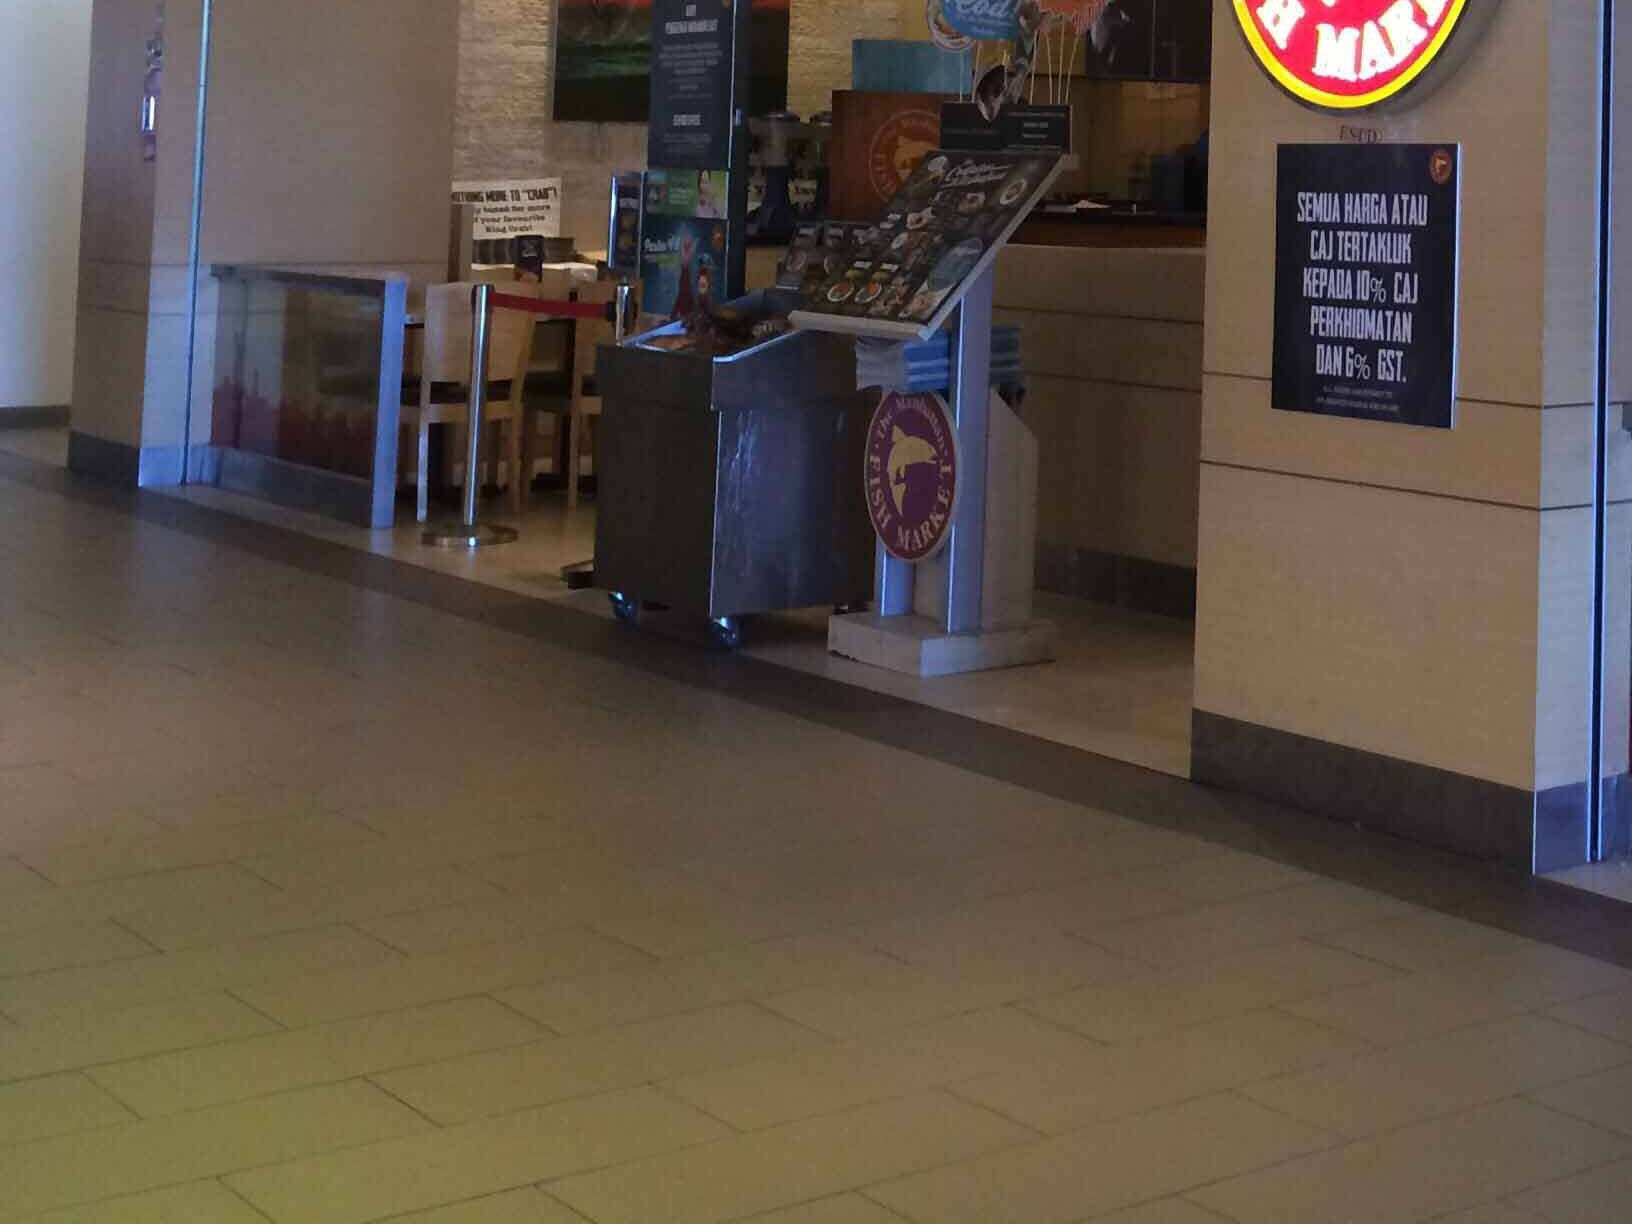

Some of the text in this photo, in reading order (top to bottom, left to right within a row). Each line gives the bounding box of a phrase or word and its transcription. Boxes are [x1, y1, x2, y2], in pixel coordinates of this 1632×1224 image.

[1297, 191, 1429, 226] SEMUA HARGA ATAU
[1310, 229, 1412, 264] CAJ TERTAKLUK
[1303, 266, 1419, 305] KEPADA 10% CAJ
[1310, 304, 1413, 345] PERKHIDMATAN
[1315, 343, 1407, 384] DAN 6% GST.
